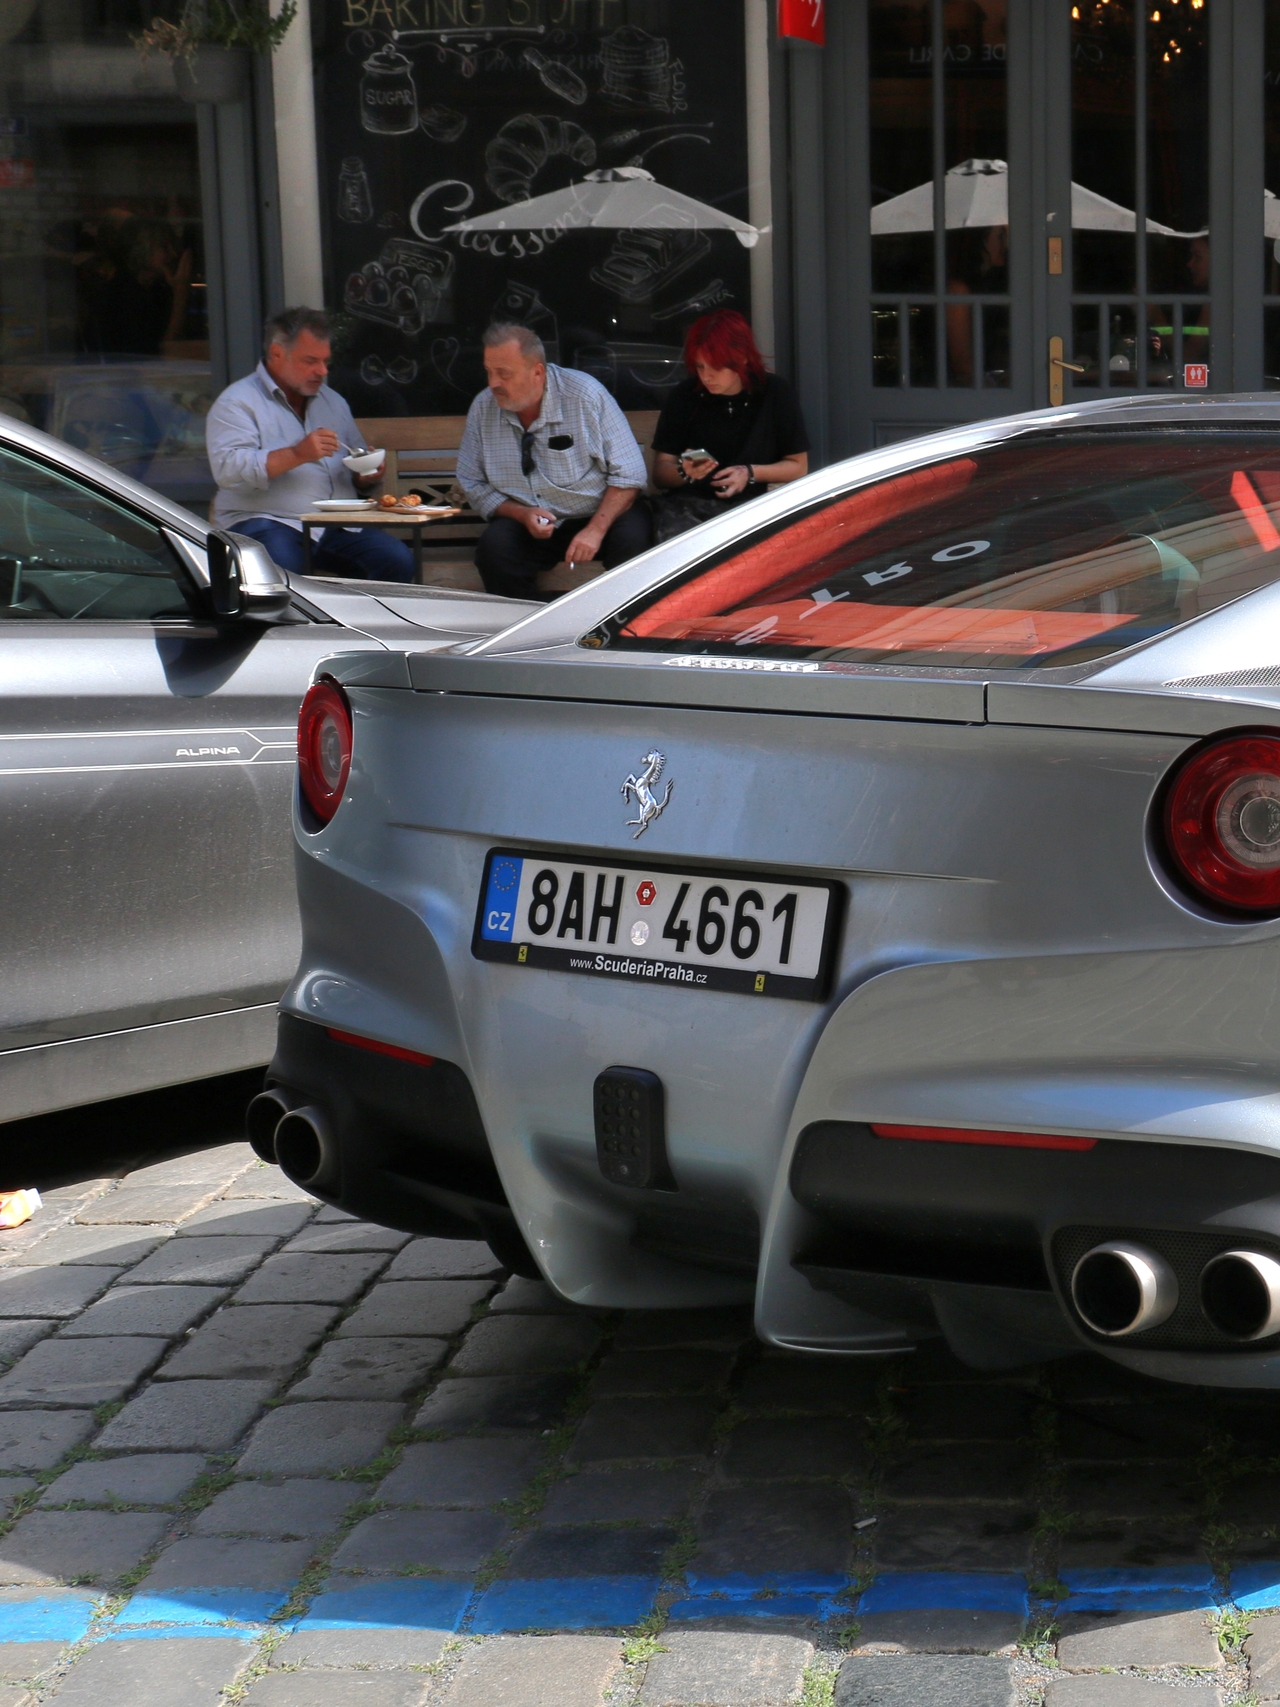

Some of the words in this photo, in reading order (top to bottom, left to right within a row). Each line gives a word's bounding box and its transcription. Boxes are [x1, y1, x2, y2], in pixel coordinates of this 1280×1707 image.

[343, 0, 485, 27] BAKING
[365, 89, 413, 106] SUGAR
[668, 58, 689, 114] FLOUR
[409, 178, 604, 258] Croissant
[175, 746, 240, 757] ALPINA
[487, 910, 510, 931] CZ
[527, 868, 625, 945] 8AH
[662, 881, 798, 965] 4661
[569, 955, 708, 985] www.ScuderiaPraha.cz
